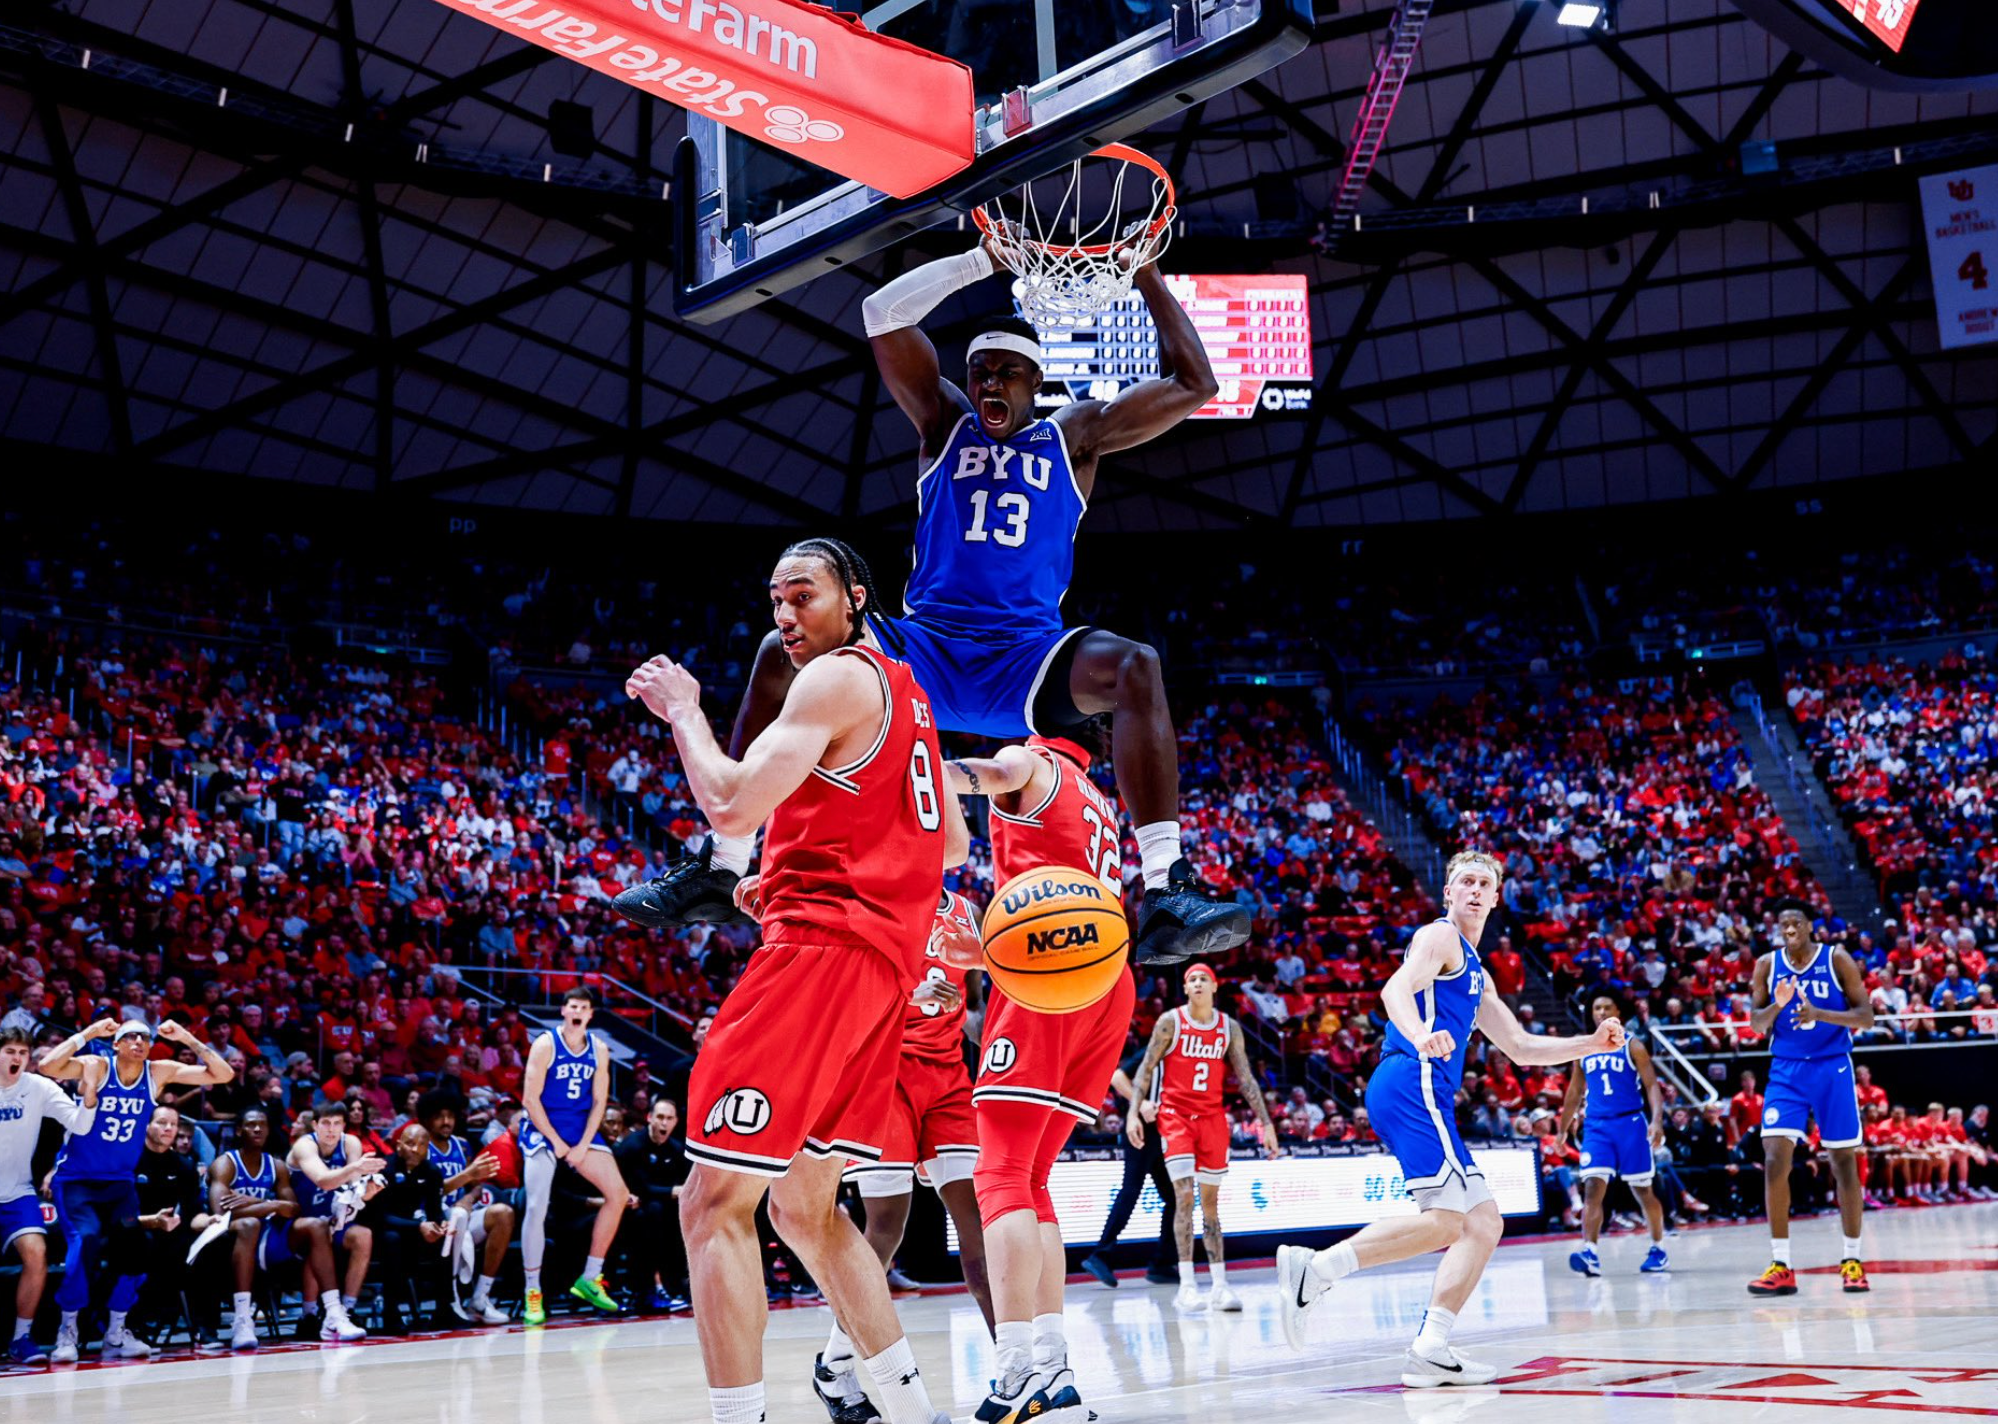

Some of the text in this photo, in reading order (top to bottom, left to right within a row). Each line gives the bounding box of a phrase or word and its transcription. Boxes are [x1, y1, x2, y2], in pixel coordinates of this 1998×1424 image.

[1958, 251, 1988, 290] 4
[953, 445, 1052, 491] BYU
[965, 489, 1030, 548] 13
[910, 738, 941, 832] 8
[1082, 804, 1122, 899] 32
[1002, 880, 1101, 915] Wilson
[1027, 923, 1099, 955] NCAA
[991, 1044, 1011, 1067] U
[1180, 1034, 1224, 1060] Utah
[556, 1062, 595, 1080] BYU
[1192, 1062, 1209, 1092] 2
[1585, 1055, 1625, 1074] BYU
[566, 1078, 582, 1099] 5
[1601, 1073, 1614, 1096] 1
[0, 1106, 24, 1121] YU
[100, 1096, 145, 1115] BYU
[732, 1094, 764, 1128] U
[101, 1116, 137, 1142] 33
